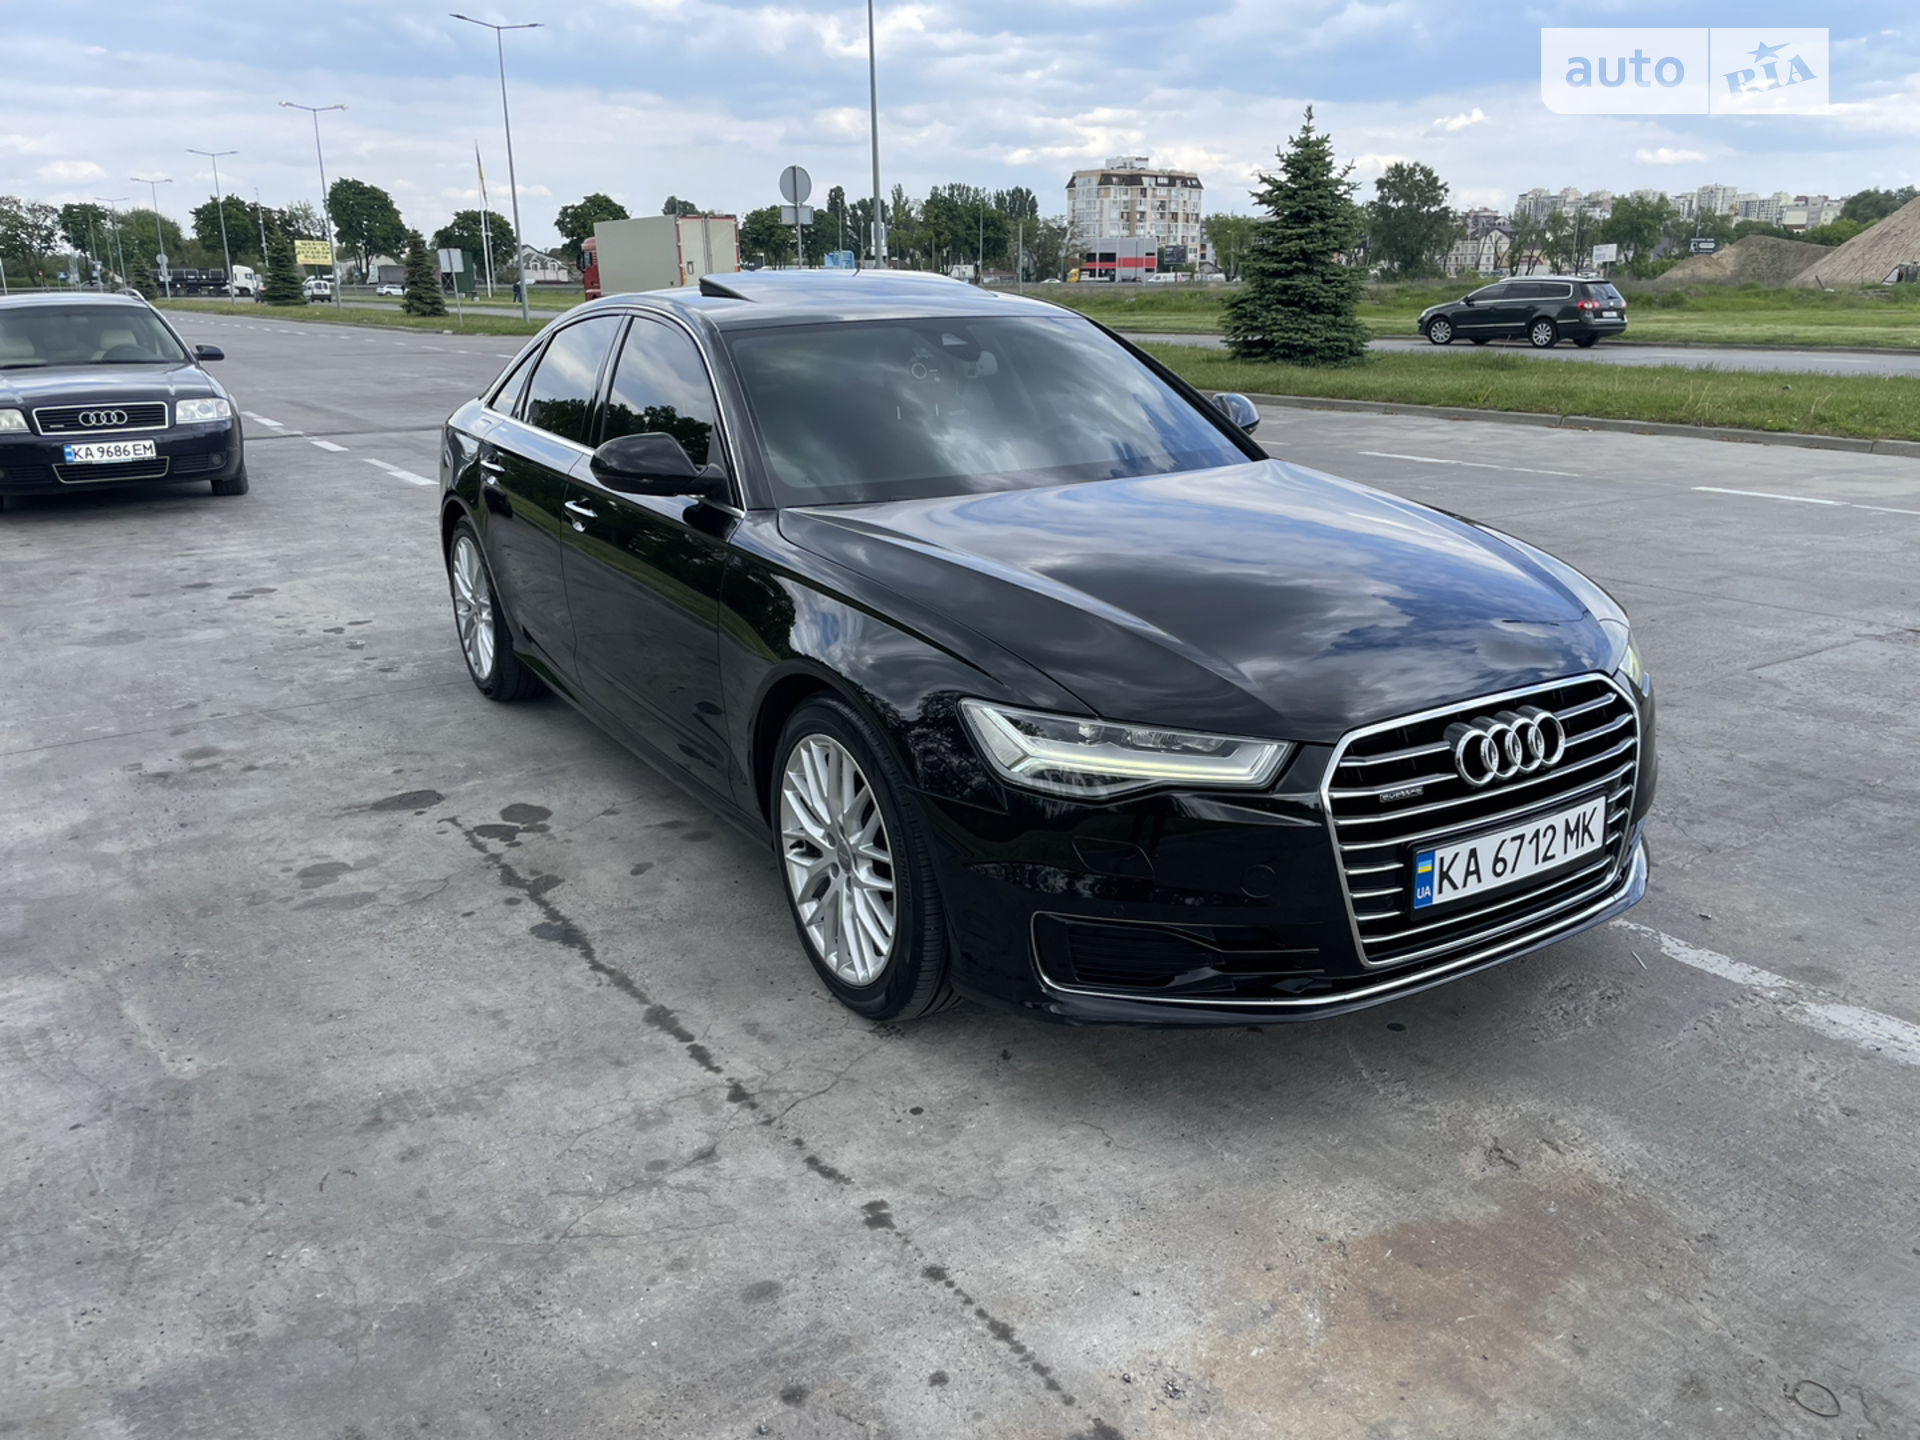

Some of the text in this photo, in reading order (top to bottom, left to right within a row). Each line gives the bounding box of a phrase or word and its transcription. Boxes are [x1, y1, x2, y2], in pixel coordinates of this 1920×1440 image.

[72, 443, 154, 460] KA 9686 EM
[1437, 806, 1598, 895] KA 6712 MK
[1416, 885, 1432, 899] UA
